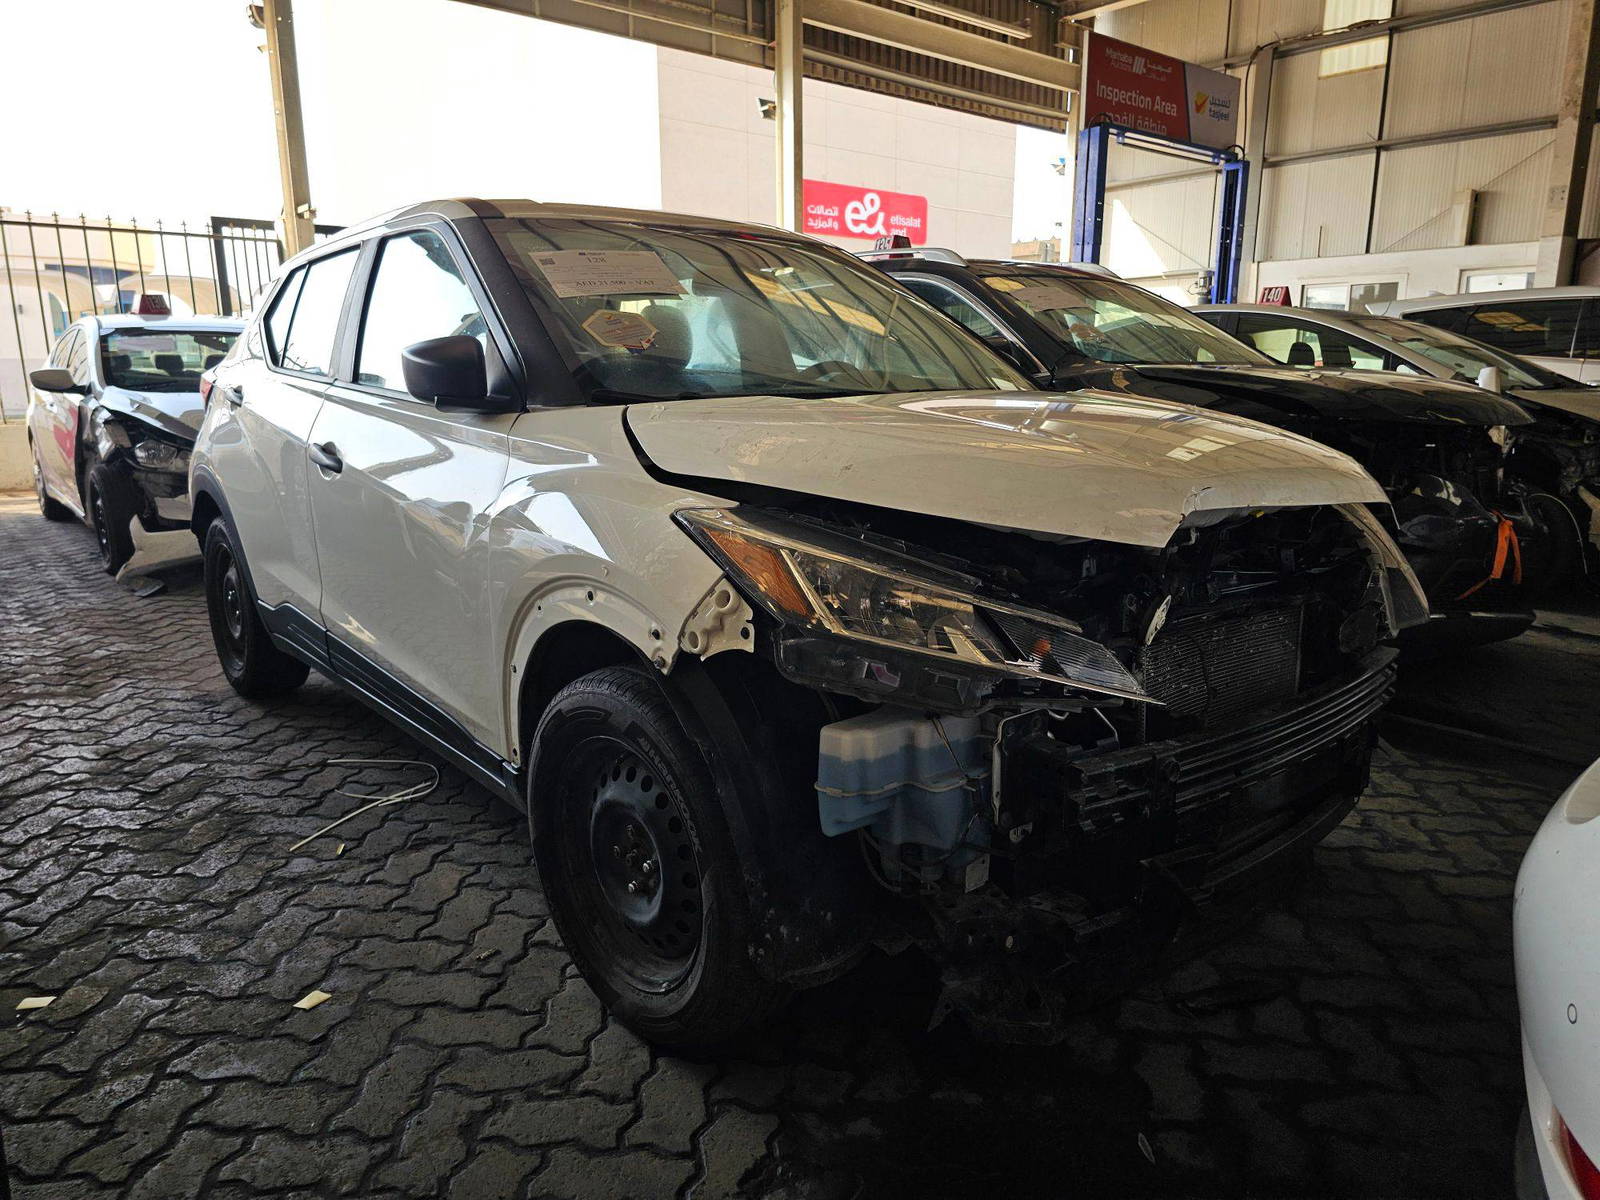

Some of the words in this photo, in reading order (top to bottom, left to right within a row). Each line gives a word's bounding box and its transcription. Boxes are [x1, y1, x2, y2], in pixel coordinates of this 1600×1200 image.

[1096, 79, 1151, 109] Inspection
[1154, 94, 1178, 117] Area
[807, 204, 840, 217] اتصالات
[889, 214, 922, 228] etisalat
[1263, 287, 1282, 303] 140
